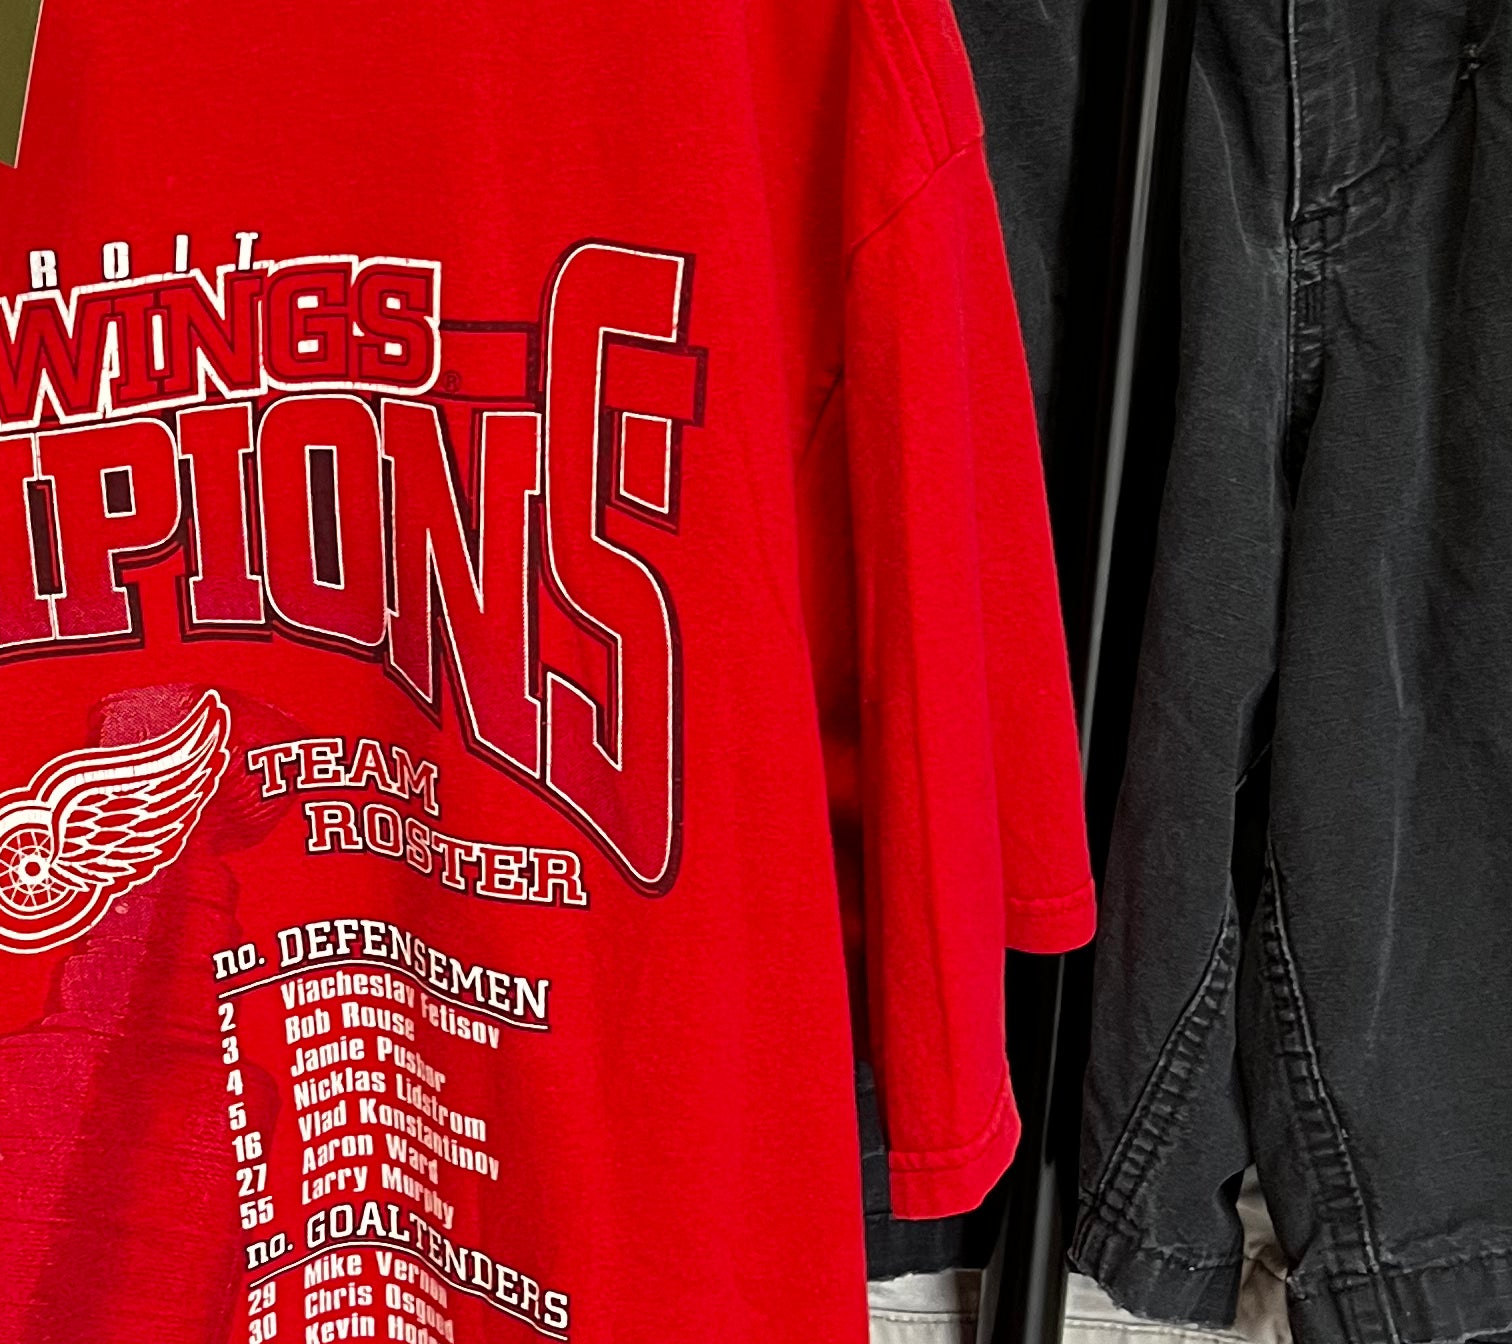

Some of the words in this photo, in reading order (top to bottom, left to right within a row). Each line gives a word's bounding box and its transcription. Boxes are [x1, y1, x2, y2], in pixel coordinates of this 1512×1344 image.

[247, 737, 441, 817] TEAM
[304, 799, 589, 909] ROSTER
[213, 943, 266, 979] no.
[277, 918, 550, 1019] DEFENSEMEN
[218, 1002, 235, 1032] 2
[281, 971, 415, 1010] Viacheslav
[421, 992, 500, 1049] Fetisov
[222, 1038, 239, 1064] 3
[285, 1009, 331, 1045] Bob
[342, 1001, 415, 1040] Rouse
[226, 1069, 243, 1095] 4
[291, 1035, 365, 1076] Jamie
[228, 1102, 247, 1130] 5
[293, 1067, 386, 1110] Nicklas
[396, 1072, 486, 1142] Lidstrom
[232, 1131, 263, 1162] 16
[298, 1101, 347, 1142] Vlad
[359, 1098, 500, 1181] Konstantinov
[236, 1164, 268, 1196] 27
[301, 1133, 374, 1174] Aaron
[385, 1133, 439, 1185] Ward
[240, 1197, 274, 1230] 55
[301, 1164, 368, 1205] Larry
[381, 1165, 455, 1230] Murphy
[246, 1232, 293, 1269] no.
[307, 1201, 569, 1330] GOALTENDERS
[247, 1281, 277, 1316] 29
[303, 1252, 362, 1290] Mike
[376, 1251, 448, 1309] Vernon
[305, 1282, 373, 1319] Chris
[386, 1287, 455, 1344] Osgood
